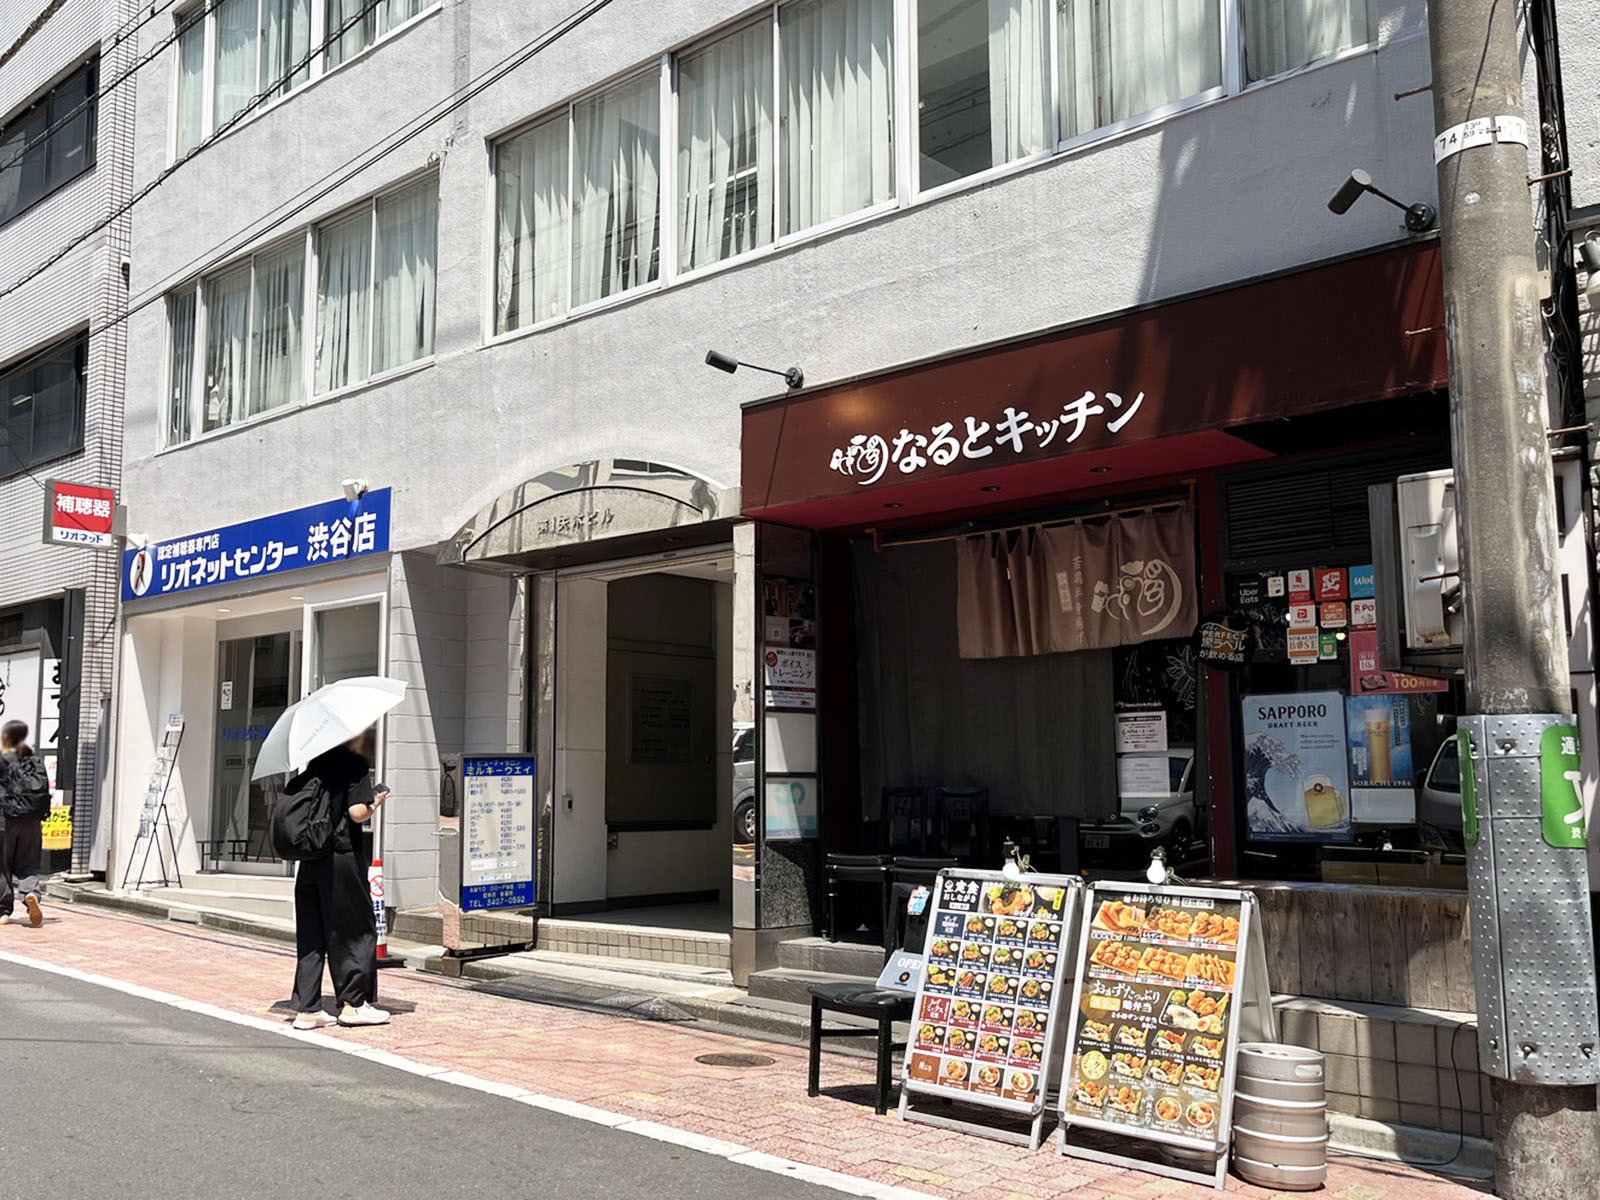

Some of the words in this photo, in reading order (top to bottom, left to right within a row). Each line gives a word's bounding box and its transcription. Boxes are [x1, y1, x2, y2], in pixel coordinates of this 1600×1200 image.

[891, 390, 1145, 474] なるとキッチン
[56, 493, 111, 518] 補聴器
[60, 530, 103, 543] リオネット
[157, 533, 219, 560] 認定補聴器専門店
[161, 540, 298, 592] リオネットセンター
[306, 511, 377, 561] 渋谷店
[1240, 588, 1257, 597] Uber
[772, 669, 813, 679] トレーニング
[1257, 704, 1327, 720] SAPPORO
[1091, 980, 1161, 1005] おかずたっぷり
